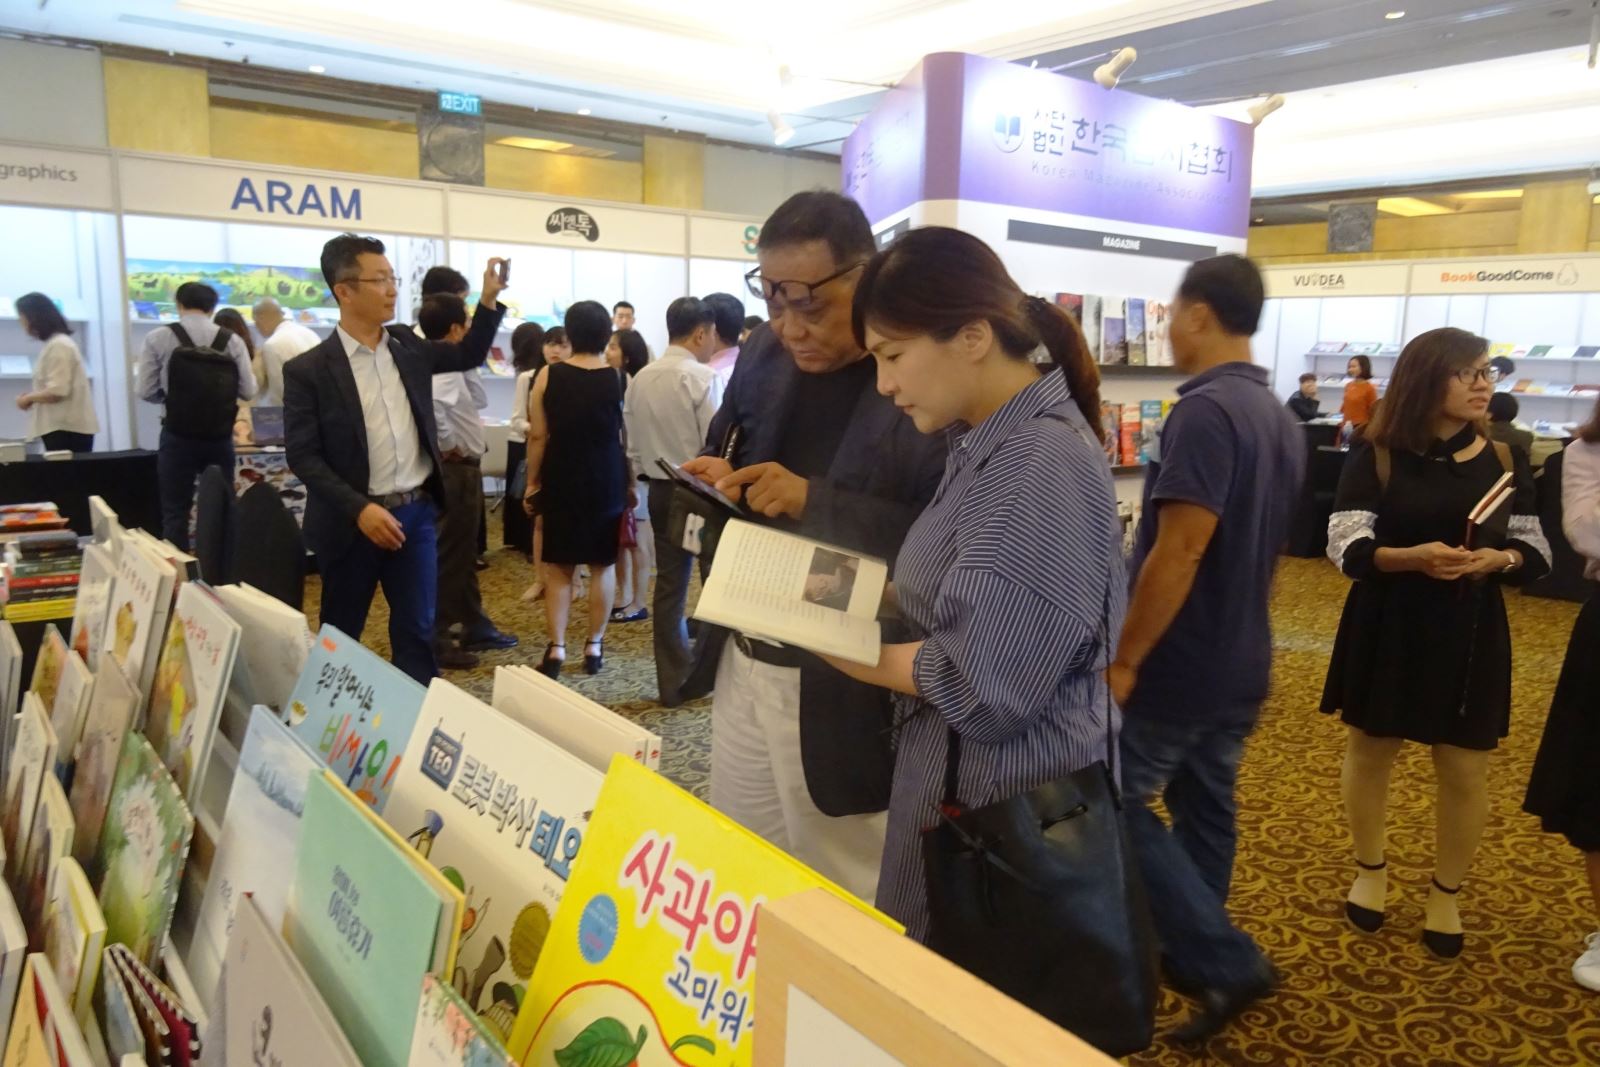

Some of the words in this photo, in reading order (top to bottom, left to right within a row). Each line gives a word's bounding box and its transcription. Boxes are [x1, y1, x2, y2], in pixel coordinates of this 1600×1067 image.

[452, 95, 480, 113] EXIT
[1033, 131, 1066, 156] 법인
[1071, 117, 1233, 183] 한국지협회
[0, 163, 78, 182] graphics
[1031, 163, 1077, 179] Korea
[230, 177, 362, 220] ARAM
[1102, 236, 1140, 250] MAGAZINE
[1440, 270, 1554, 282] BookGoodCome
[428, 745, 453, 777] TEO
[529, 810, 582, 882] 테오
[624, 838, 758, 980] 사과야
[668, 955, 754, 1043] 고마워
